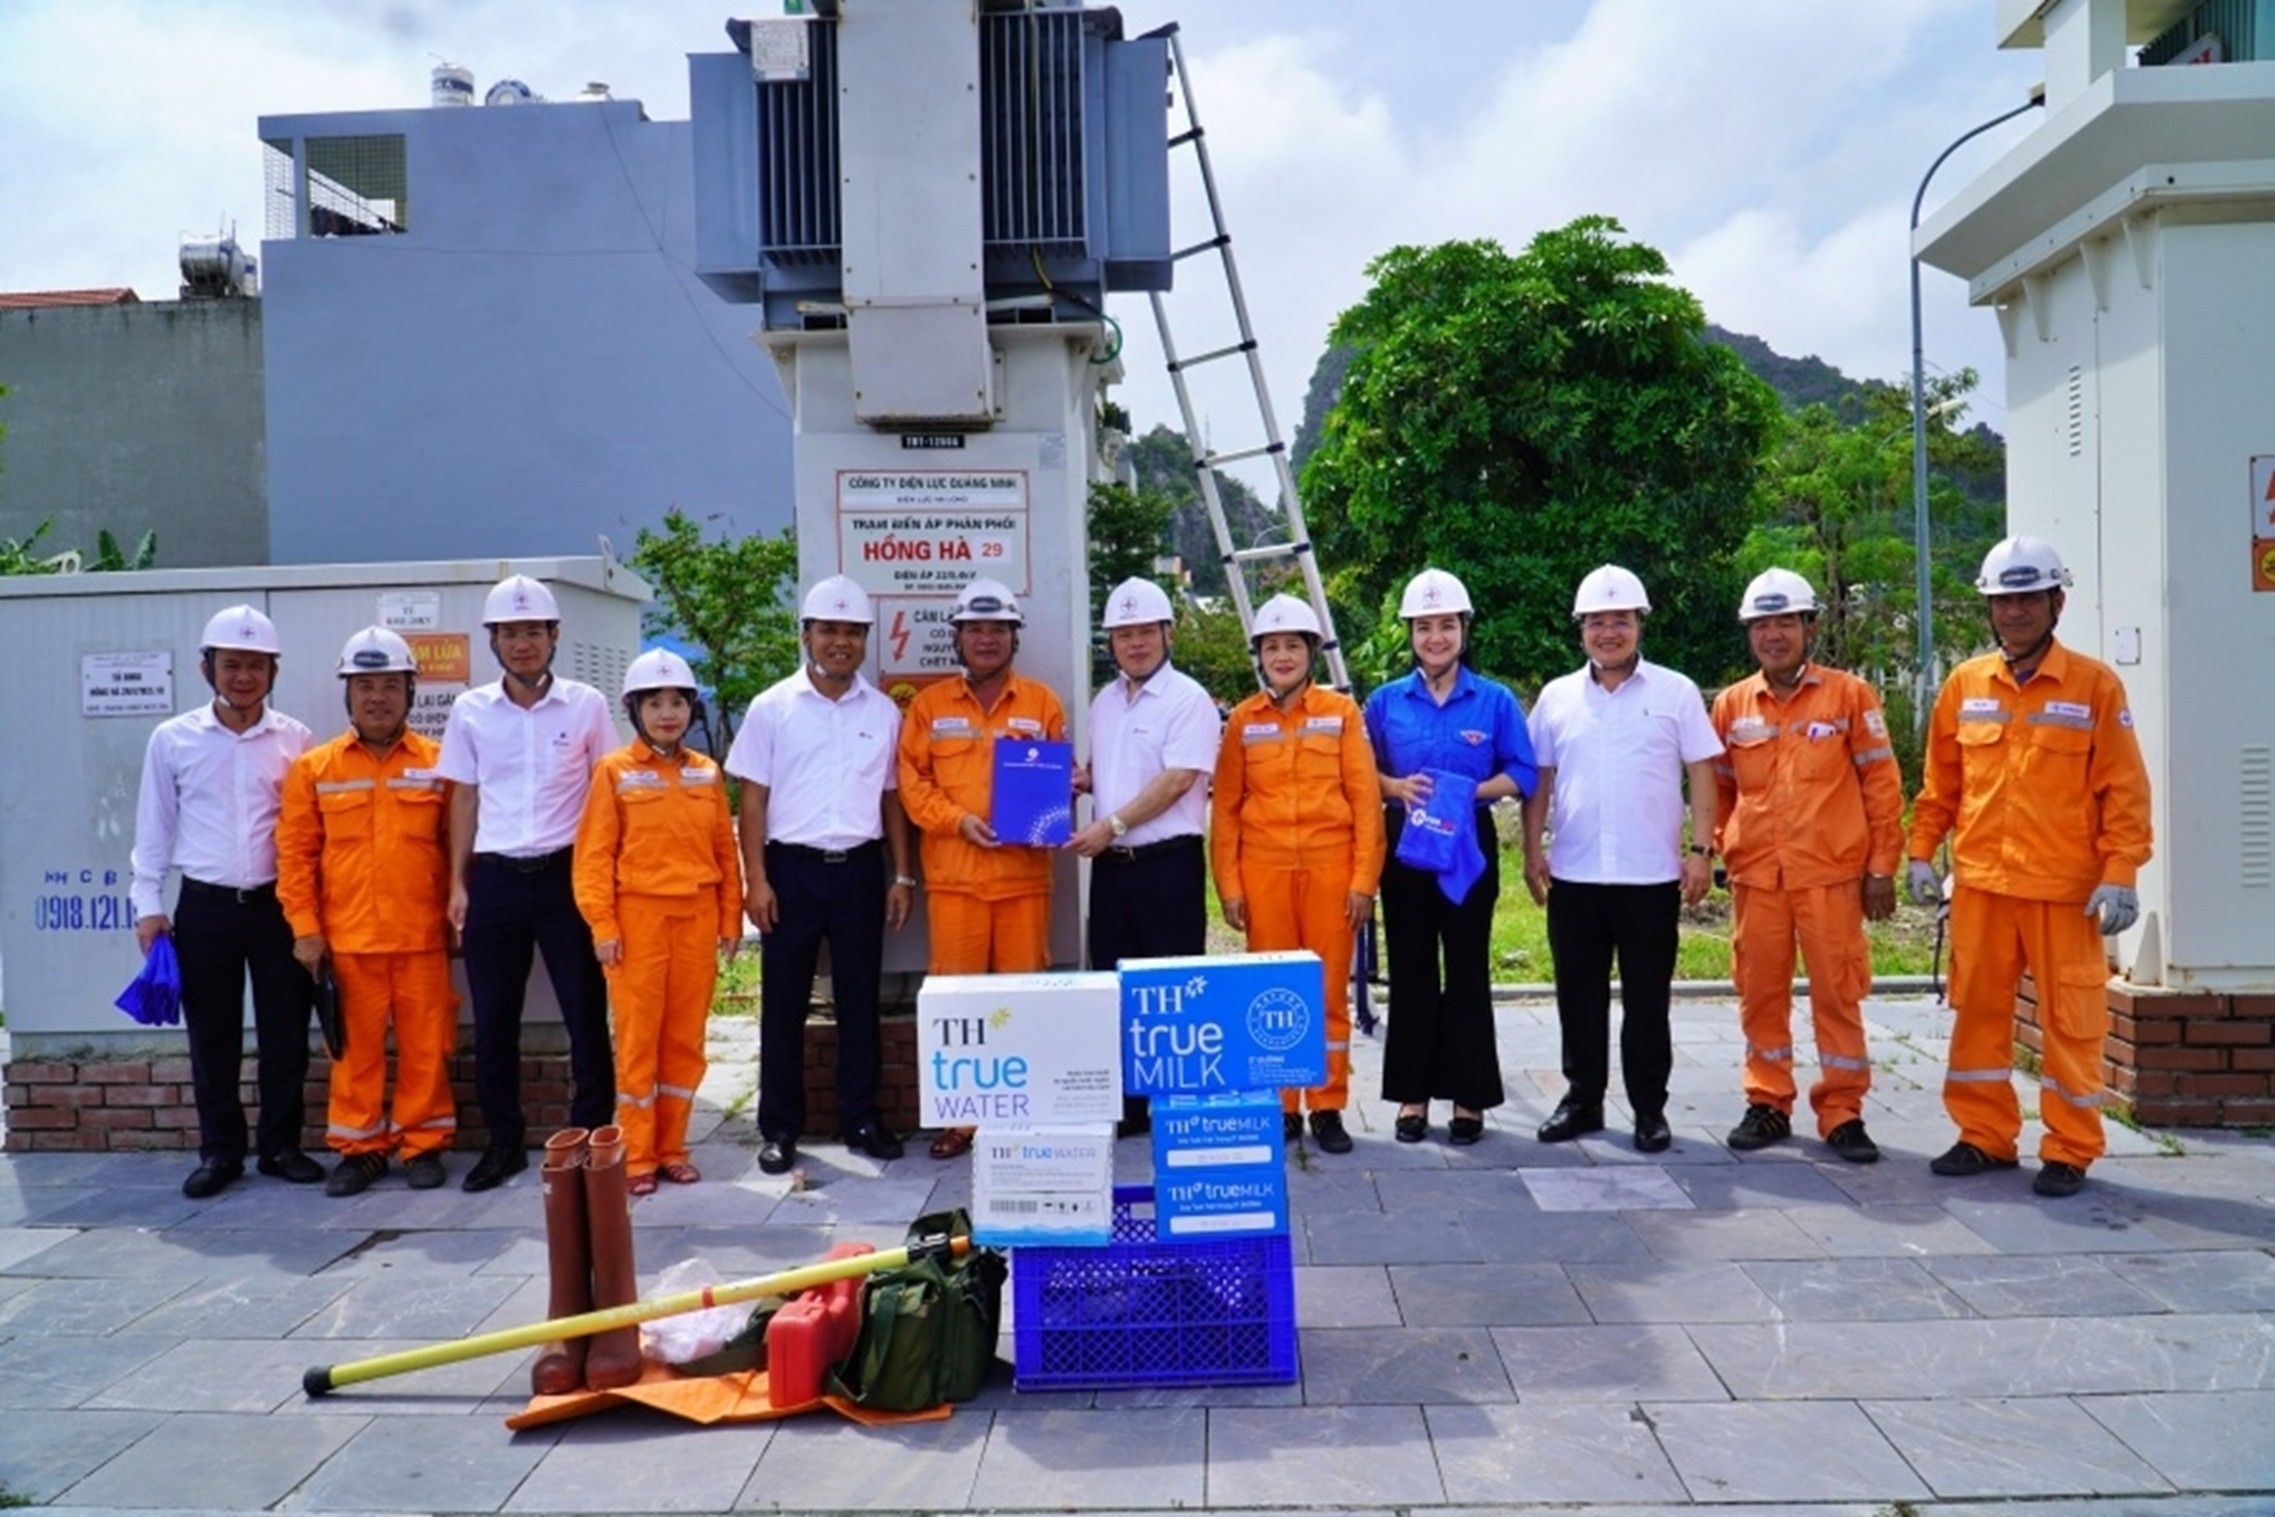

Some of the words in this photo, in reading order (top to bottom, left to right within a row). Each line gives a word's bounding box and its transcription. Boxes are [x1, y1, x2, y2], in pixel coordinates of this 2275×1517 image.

[884, 477, 896, 489] TY
[981, 542, 1003, 557] 29
[35, 894, 137, 931] 0918.121.1
[1131, 985, 1183, 1015] TH
[932, 1018, 985, 1046] TH
[1260, 1010, 1293, 1029] TH
[1129, 1018, 1223, 1057] true
[932, 1050, 1028, 1090] true
[1134, 1053, 1226, 1090] MILK
[934, 1094, 1030, 1119] WATER
[1165, 1119, 1190, 1134] TH
[1167, 1185, 1192, 1201] TH
